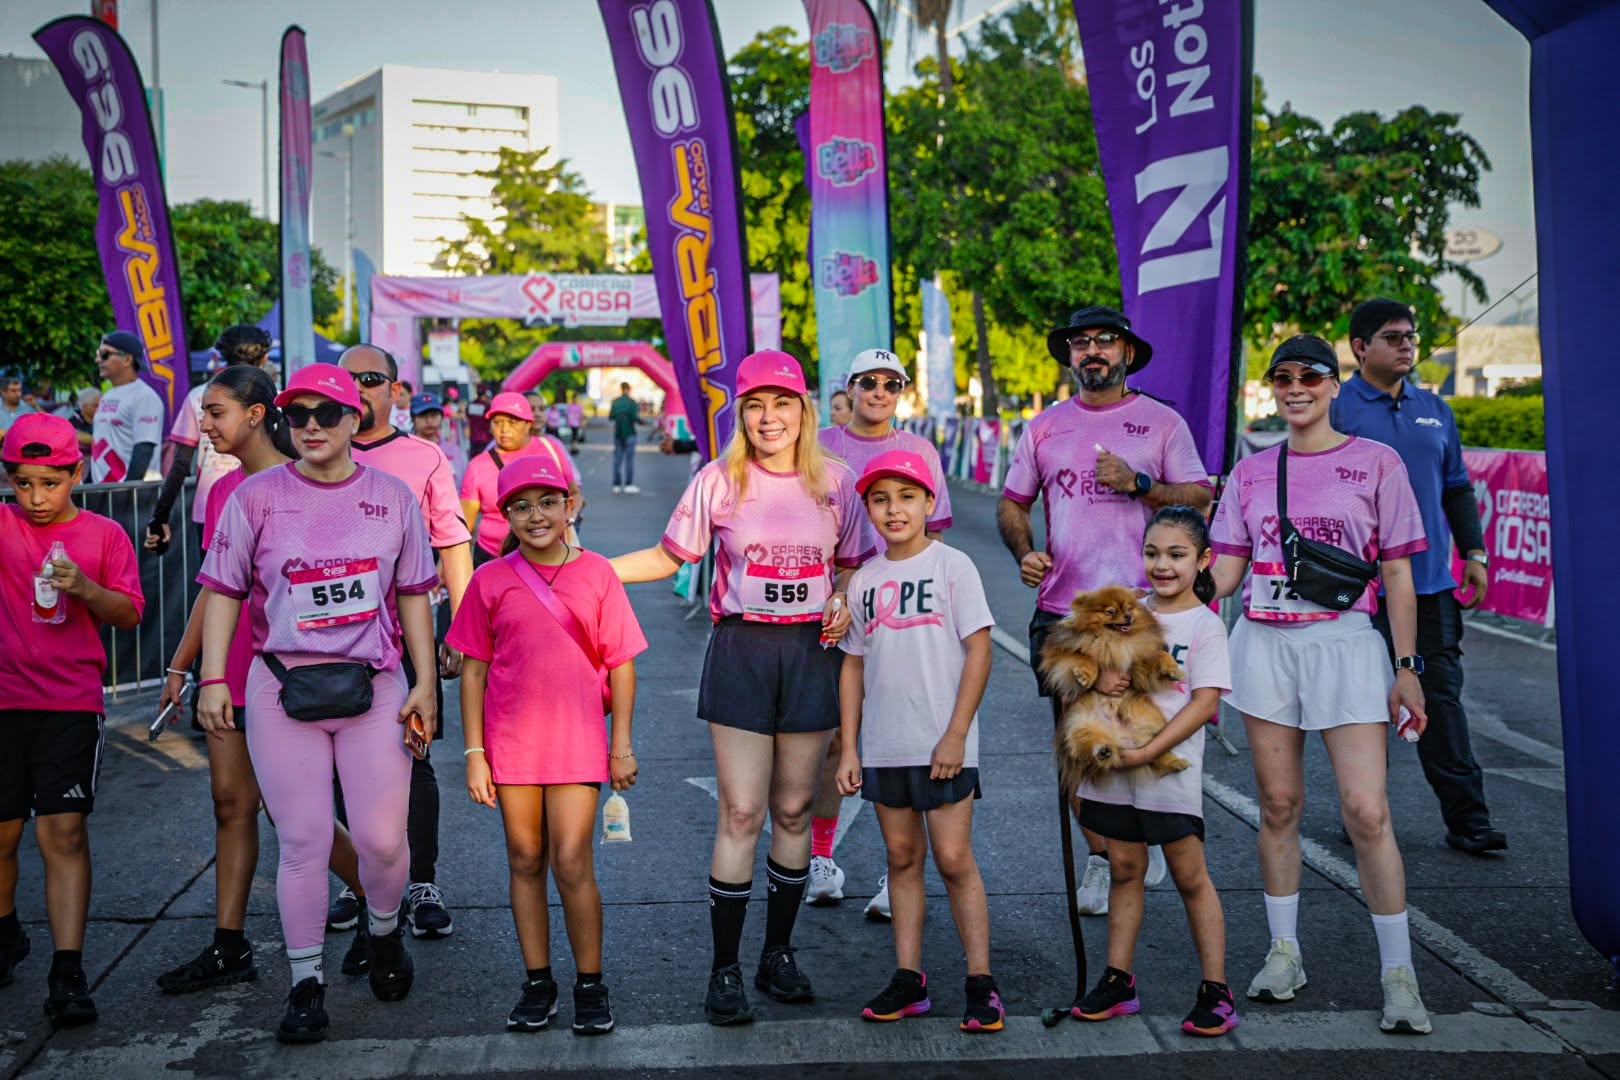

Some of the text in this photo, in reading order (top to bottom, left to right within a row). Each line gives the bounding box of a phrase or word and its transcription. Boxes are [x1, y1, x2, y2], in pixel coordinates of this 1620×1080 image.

[1130, 39, 1158, 135] Los
[691, 142, 710, 209] RADIO
[560, 290, 632, 312] ROSA
[1126, 422, 1150, 435] DIF
[1340, 468, 1368, 482] DIF
[364, 503, 389, 518] DIF
[311, 579, 365, 607] 554
[764, 582, 809, 604] 559
